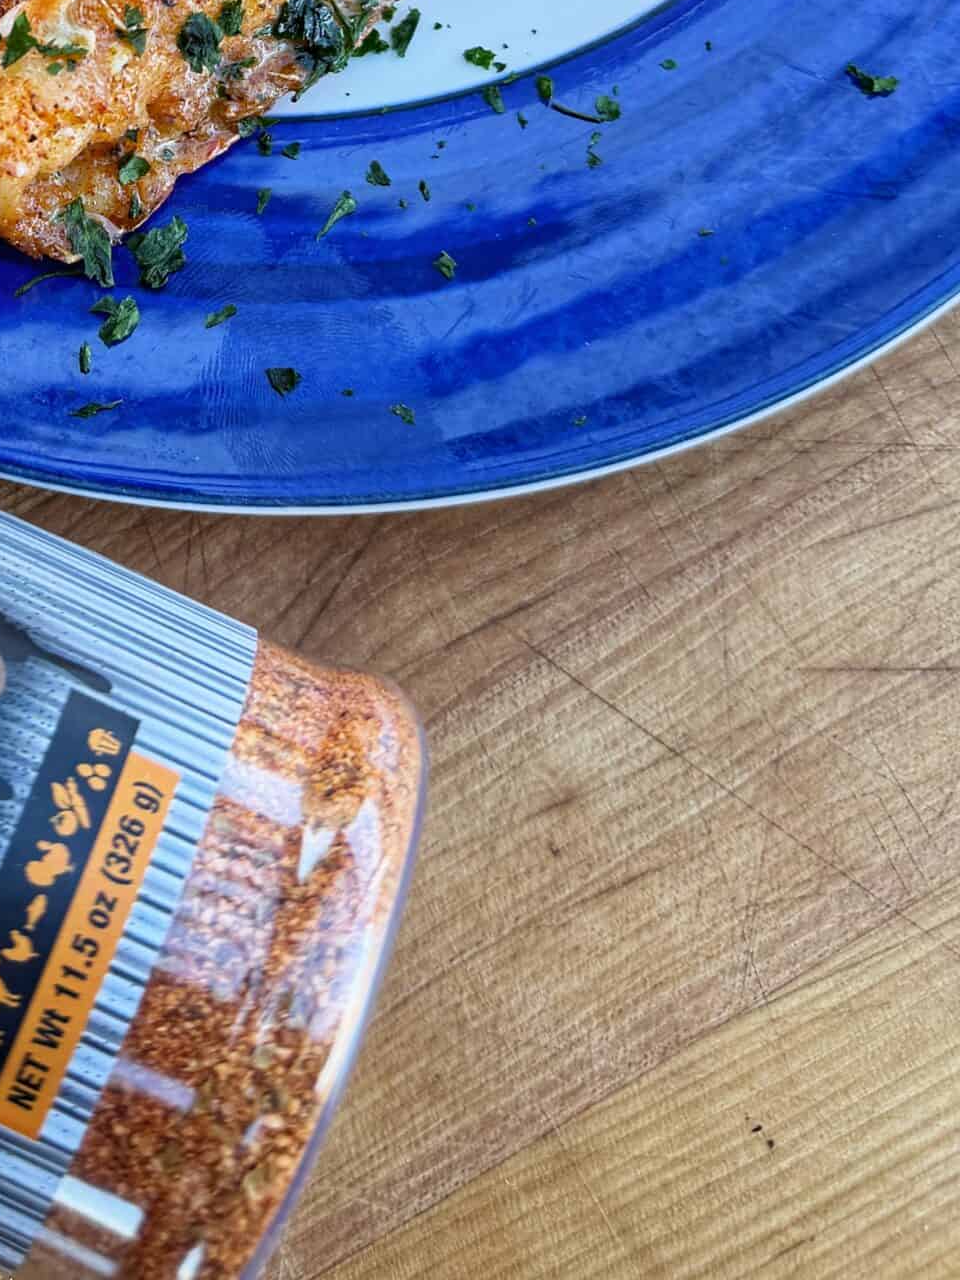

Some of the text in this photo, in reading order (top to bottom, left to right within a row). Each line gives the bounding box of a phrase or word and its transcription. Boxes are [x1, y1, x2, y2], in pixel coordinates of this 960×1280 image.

[7, 780, 165, 1111] NET Wt 11.5 oz (326 g)
